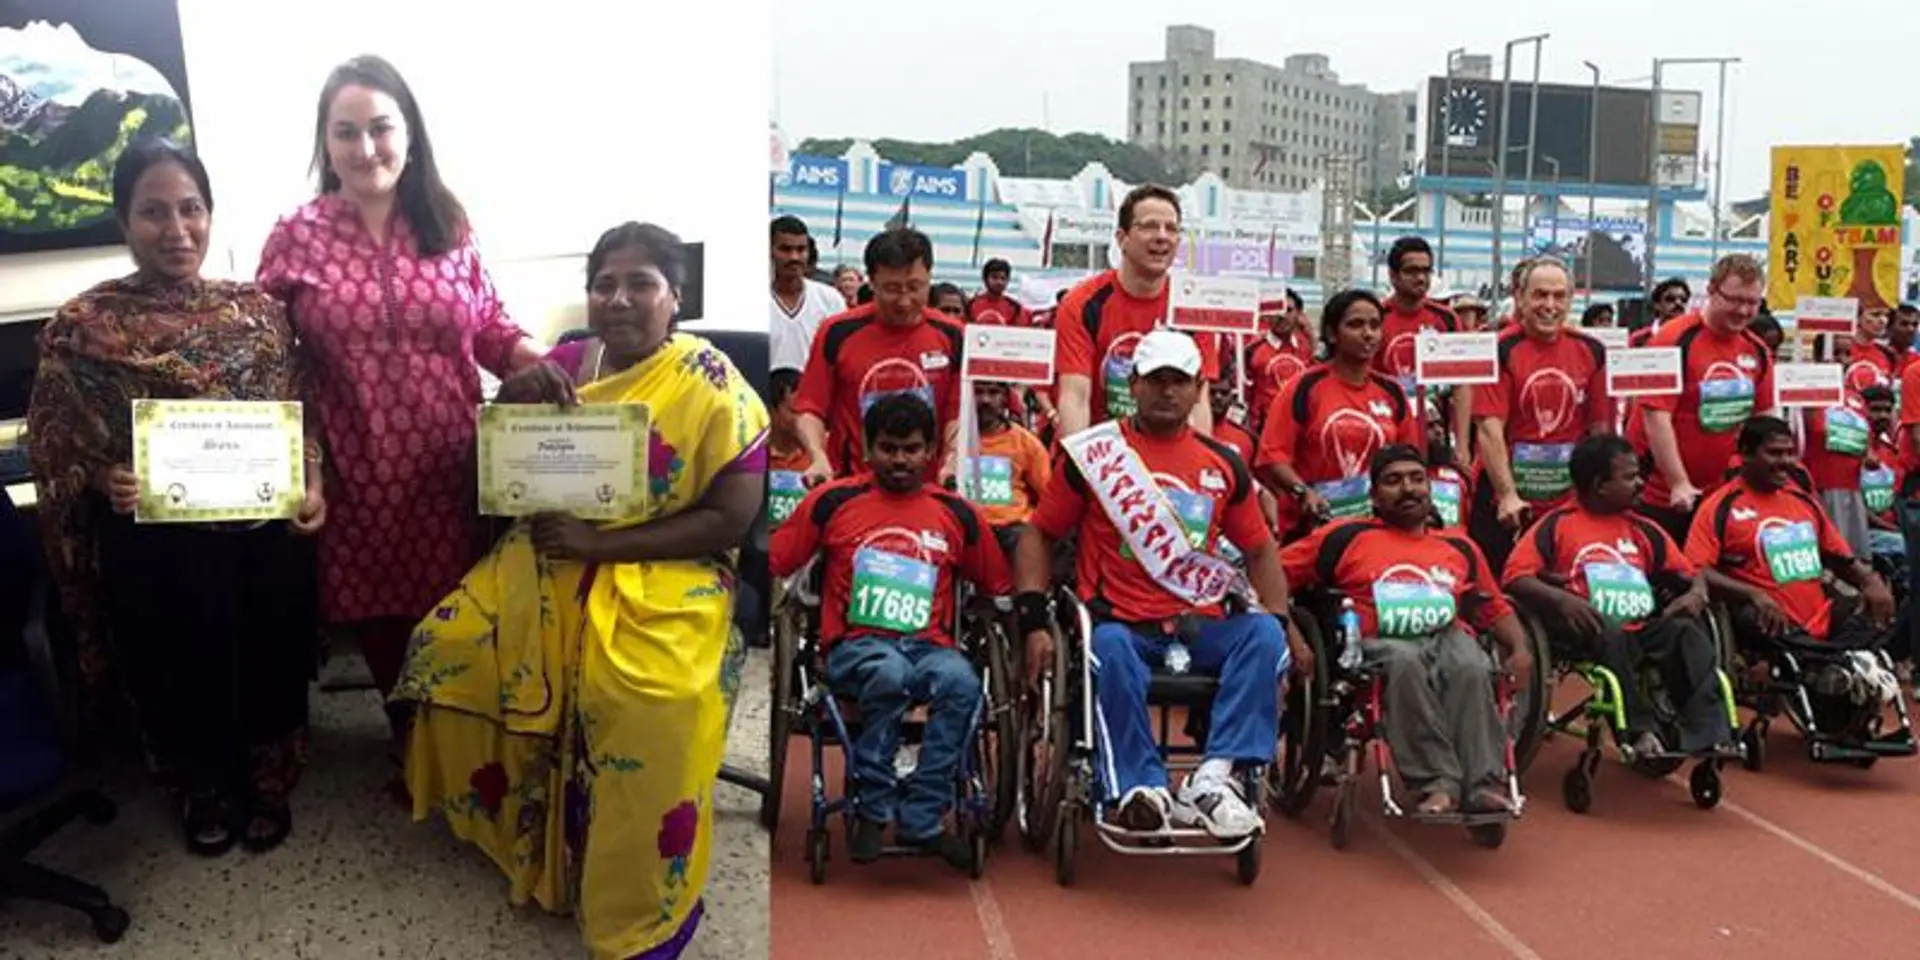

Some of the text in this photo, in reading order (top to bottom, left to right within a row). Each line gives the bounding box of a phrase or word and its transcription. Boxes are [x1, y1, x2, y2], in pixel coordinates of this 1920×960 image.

[796, 164, 840, 186] AIMS
[914, 174, 958, 195] AIMS
[1785, 165, 1799, 200] BE
[1835, 227, 1897, 245] TEAM
[1086, 439, 1114, 464] Mr
[1772, 545, 1822, 577] 17691
[856, 585, 931, 629] 17685
[1594, 588, 1655, 618] 17689
